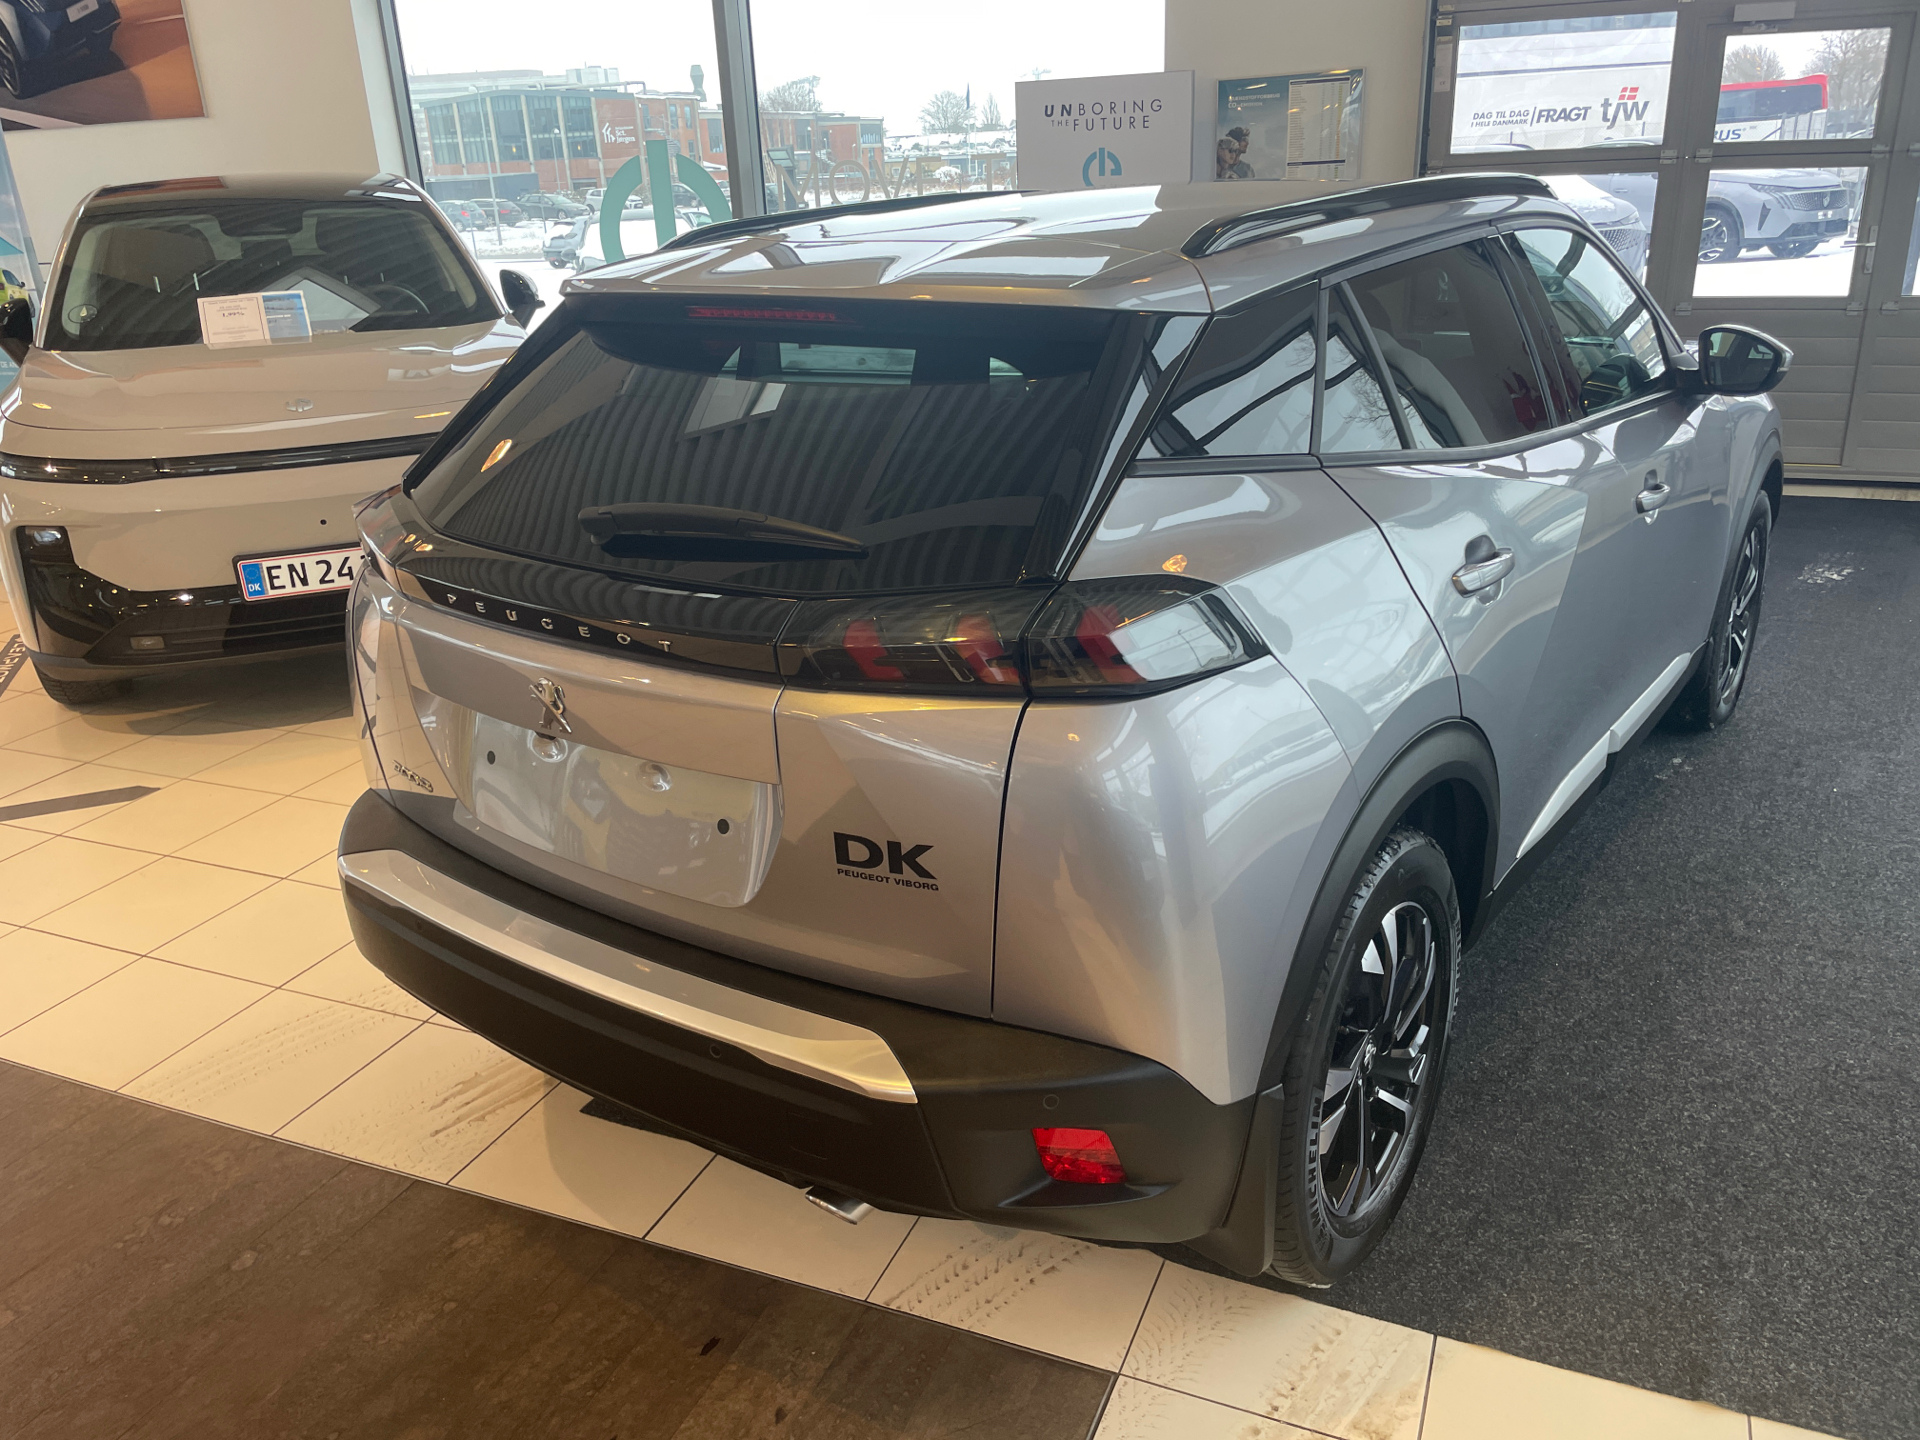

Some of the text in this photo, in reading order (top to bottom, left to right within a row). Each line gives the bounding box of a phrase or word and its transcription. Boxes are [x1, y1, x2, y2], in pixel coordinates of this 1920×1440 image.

[1044, 98, 1162, 118] UNBORING
[1472, 109, 1530, 120] DAG TIL DAG
[1536, 106, 1592, 124] FRAGT
[1073, 115, 1150, 132] FUTURE
[1492, 118, 1529, 127] DANMARK
[776, 152, 1018, 213] MOVE T
[266, 556, 354, 590] EN 24
[248, 583, 261, 592] DK
[446, 593, 671, 653] PEUGEOT
[833, 831, 937, 880] DK
[837, 868, 939, 891] PEUGEOT VIBORG
[1308, 1096, 1323, 1230] MICHELIN
